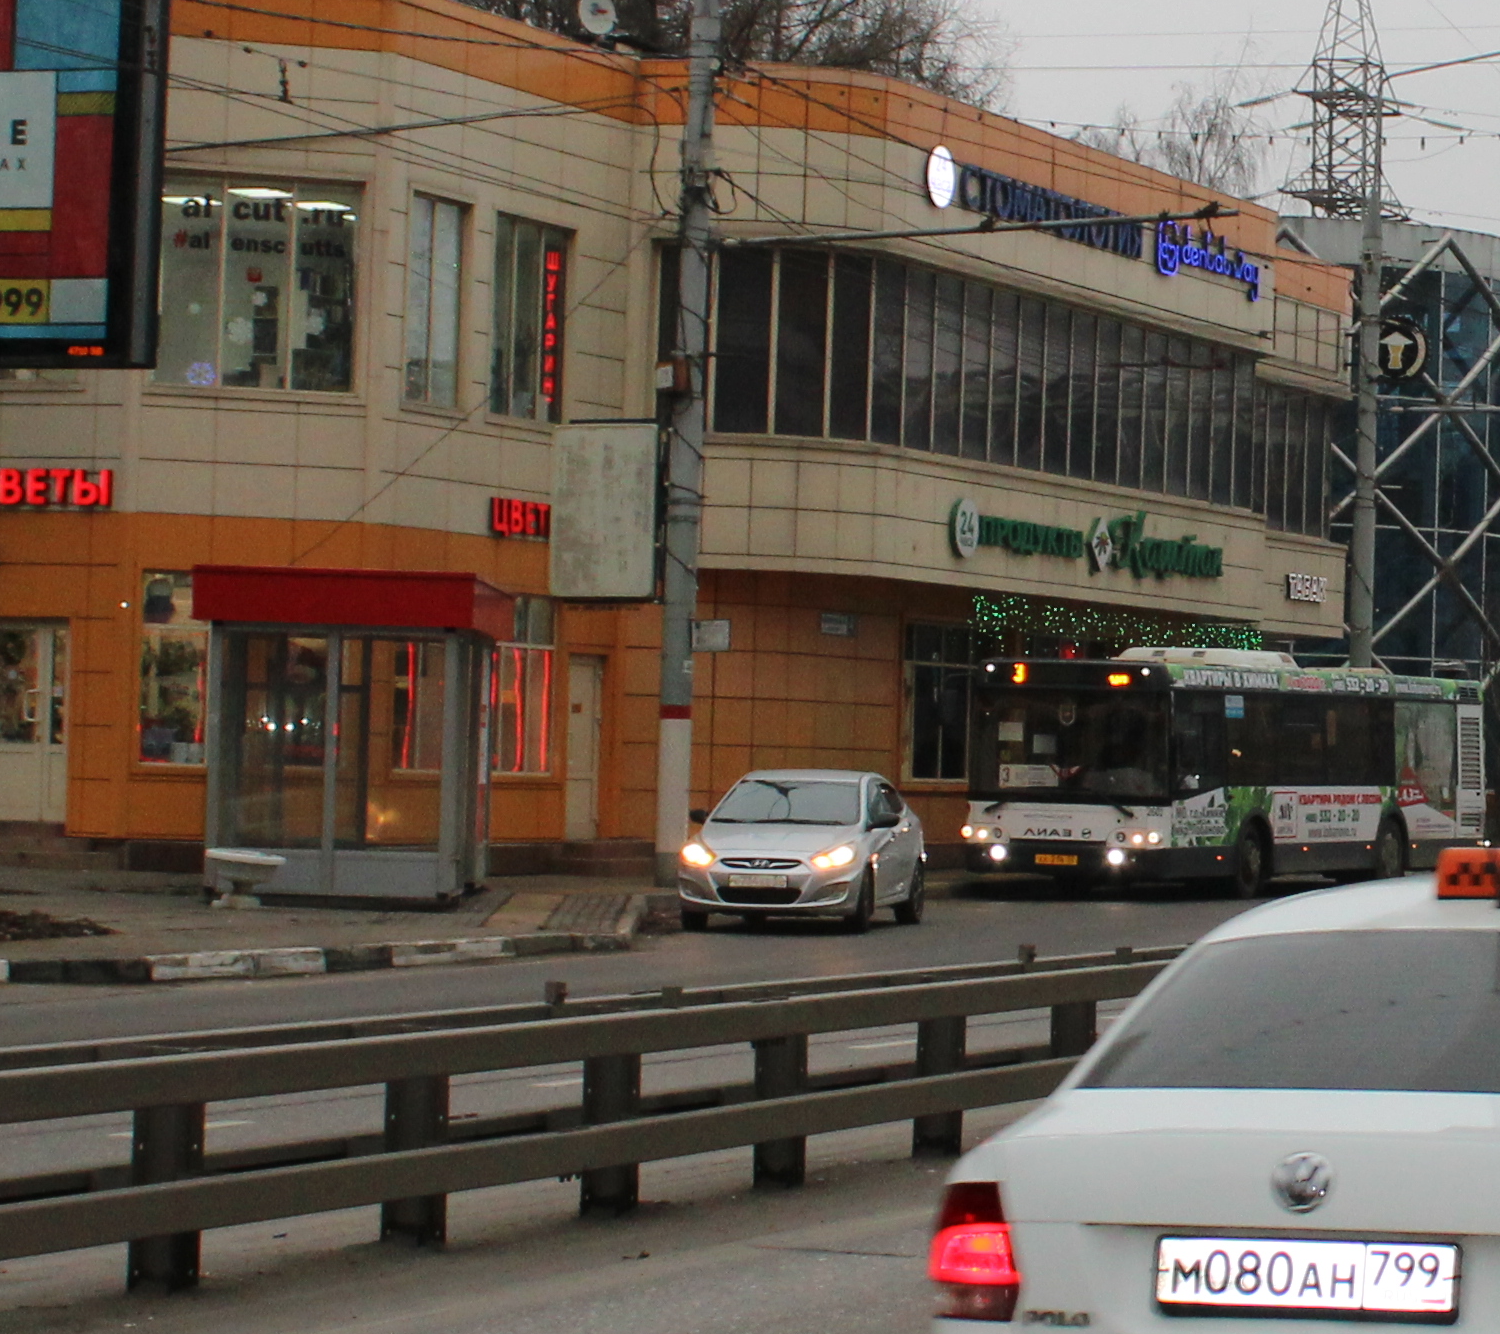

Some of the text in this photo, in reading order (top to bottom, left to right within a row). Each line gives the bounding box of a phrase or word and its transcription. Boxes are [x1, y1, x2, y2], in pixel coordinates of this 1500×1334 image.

[960, 510, 974, 537] 24
[978, 514, 1084, 558] ПРОДУКТЫ
[1286, 572, 1329, 603] ТАБАК
[1011, 662, 1028, 685] 3
[1370, 1250, 1440, 1288] 799
[1022, 1310, 1091, 1327] POLO
